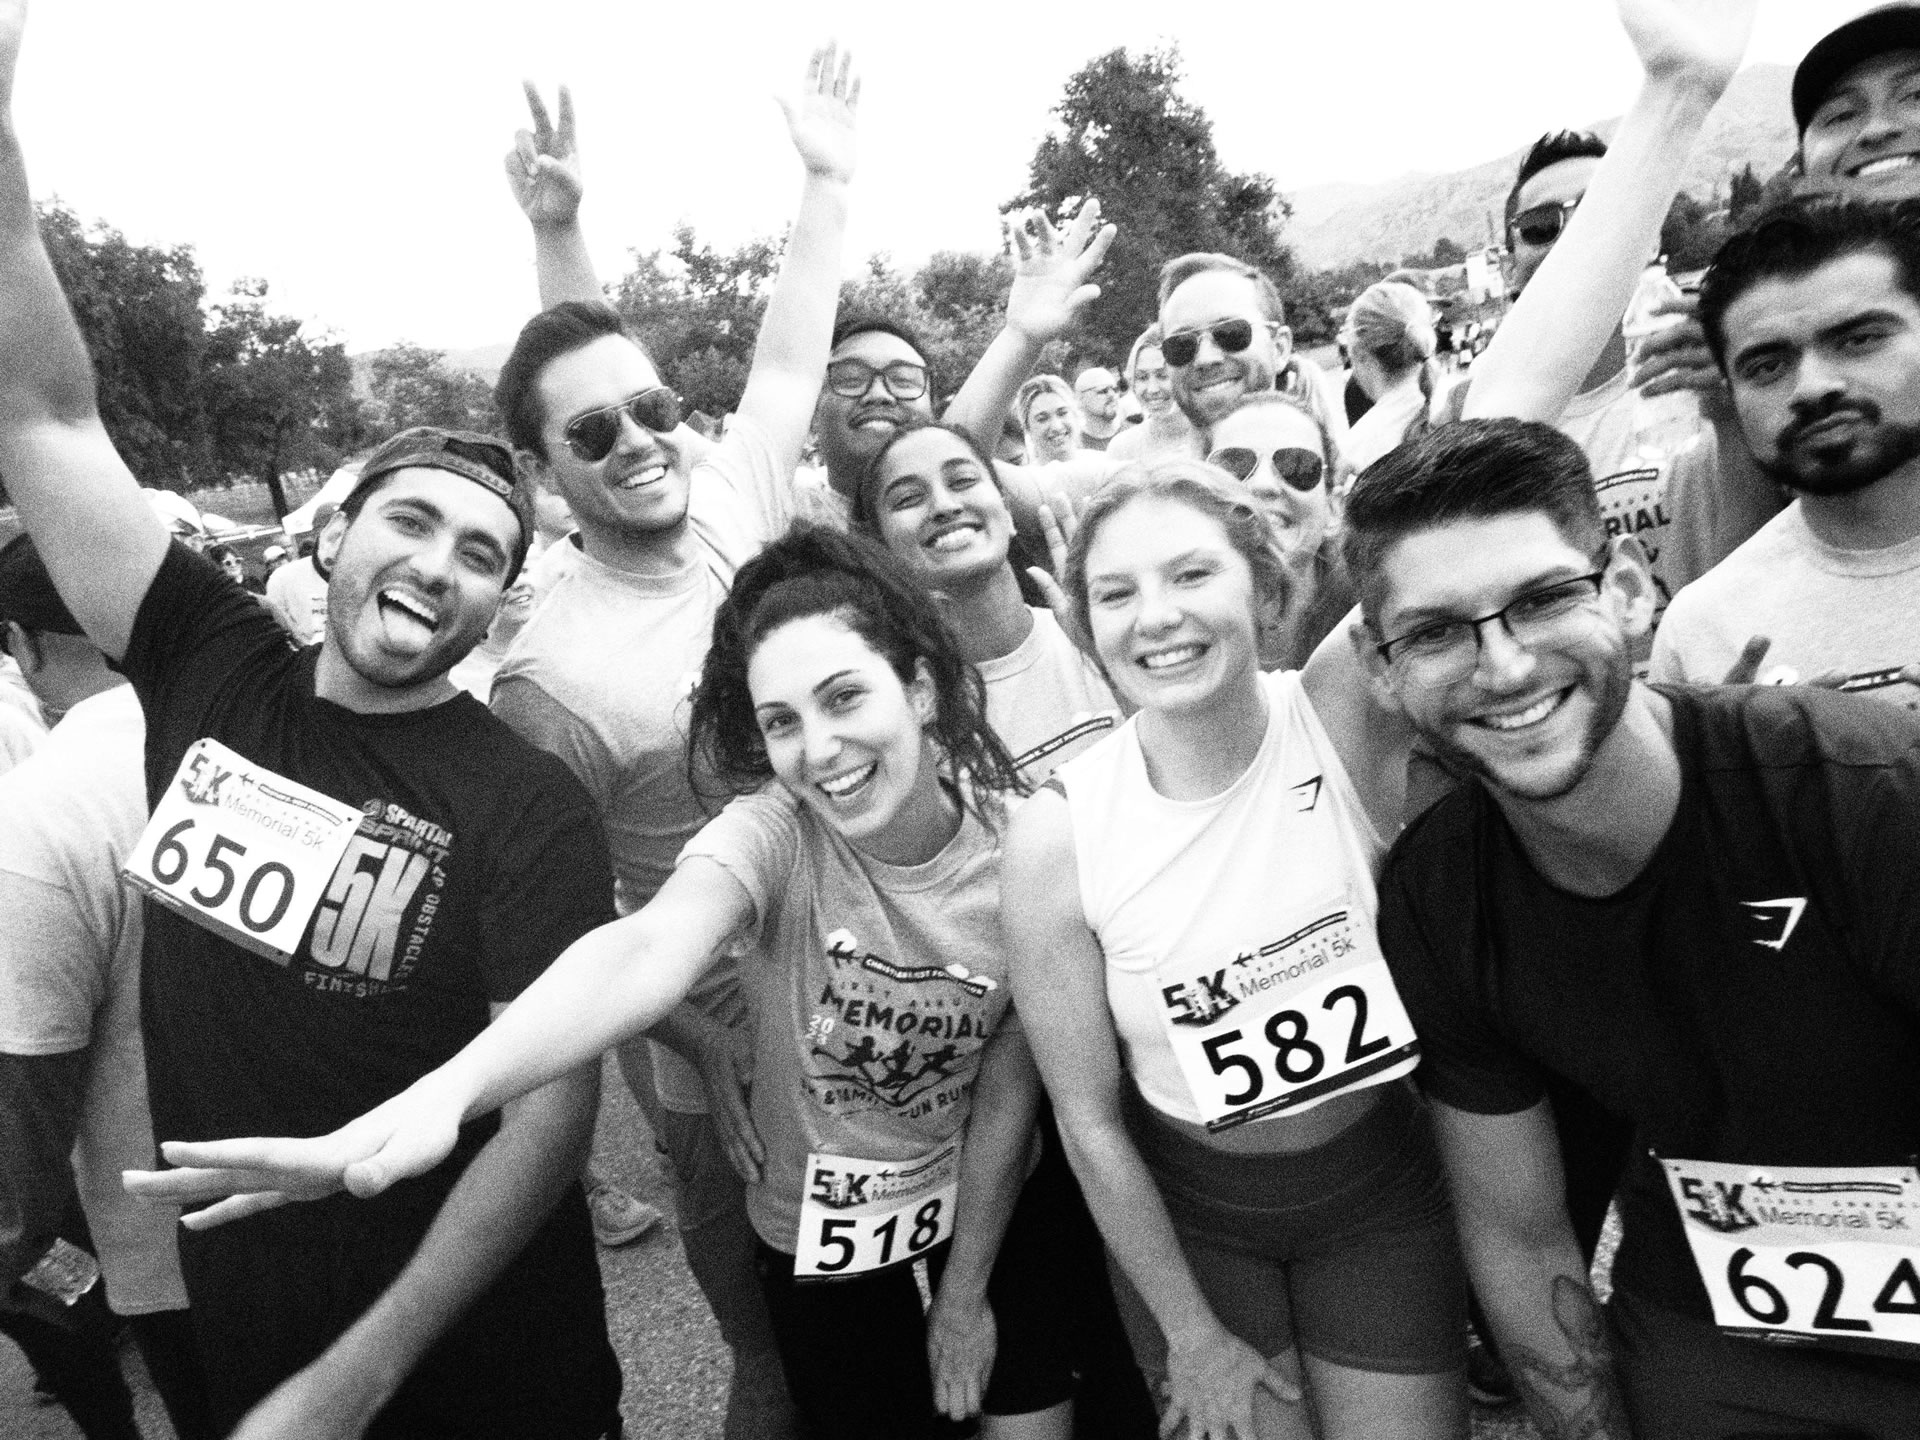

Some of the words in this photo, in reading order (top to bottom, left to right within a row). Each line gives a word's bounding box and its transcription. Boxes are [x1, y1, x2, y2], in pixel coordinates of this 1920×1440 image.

[181, 753, 232, 806] 5K
[224, 793, 299, 840] Memorial
[302, 829, 324, 850] 5k
[152, 818, 295, 933] 650
[309, 834, 430, 982] 5K
[1239, 949, 1329, 999] Memorial
[1332, 936, 1357, 959] 5k
[821, 983, 988, 1041] MEMORIAL
[1162, 969, 1240, 1028] 5K
[1201, 984, 1392, 1106] 582
[810, 1168, 871, 1209] 5K
[1679, 1176, 1759, 1233] 5K
[1756, 1205, 1871, 1229] Memorial
[815, 1198, 942, 1272] 518
[1727, 1247, 1920, 1332] 624
